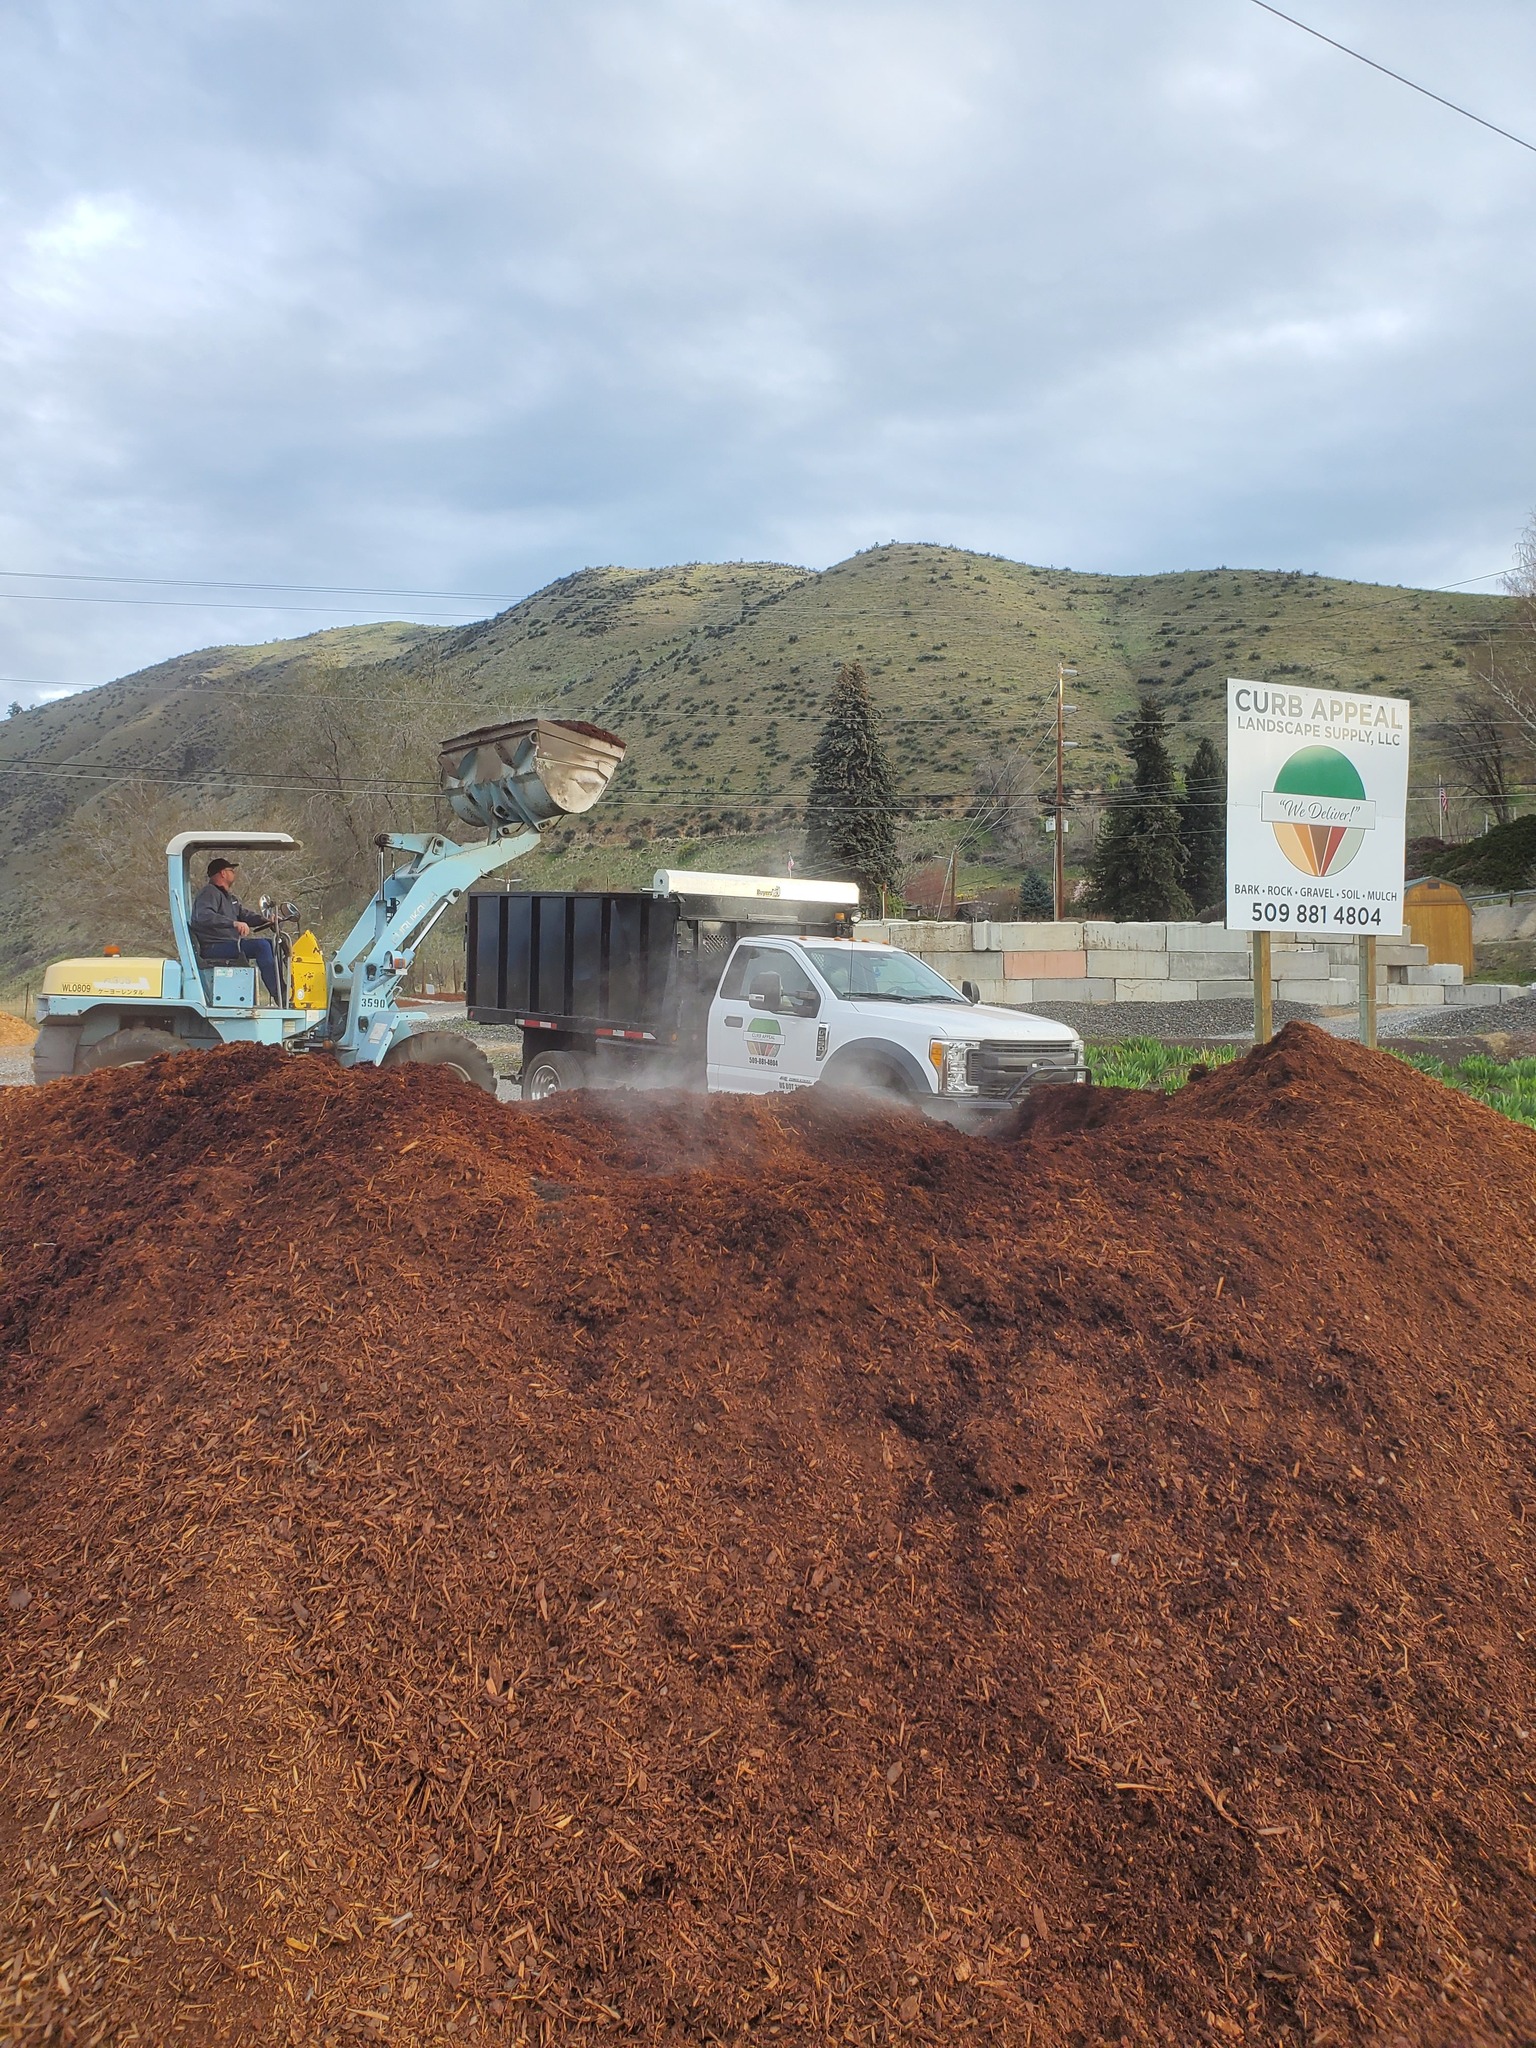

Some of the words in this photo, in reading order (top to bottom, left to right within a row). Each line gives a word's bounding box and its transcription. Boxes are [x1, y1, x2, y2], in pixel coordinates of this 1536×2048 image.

[1235, 688, 1303, 718] CURB
[1310, 698, 1403, 730] APPEAL
[1237, 716, 1321, 738] LANDSCAPE
[1324, 726, 1374, 746] SUPPLY,
[1378, 731, 1401, 746] LLC
[1234, 883, 1260, 895] BARK
[1267, 885, 1293, 897] ROCK
[1300, 887, 1334, 899] GRAVEL
[1341, 889, 1361, 900] SOIL
[1367, 891, 1397, 902] MULCH
[1251, 902, 1290, 923] 509
[1296, 904, 1327, 924] 881
[1333, 906, 1382, 926] 4804
[62, 983, 91, 993] WL0809
[361, 998, 386, 1009] 3590
